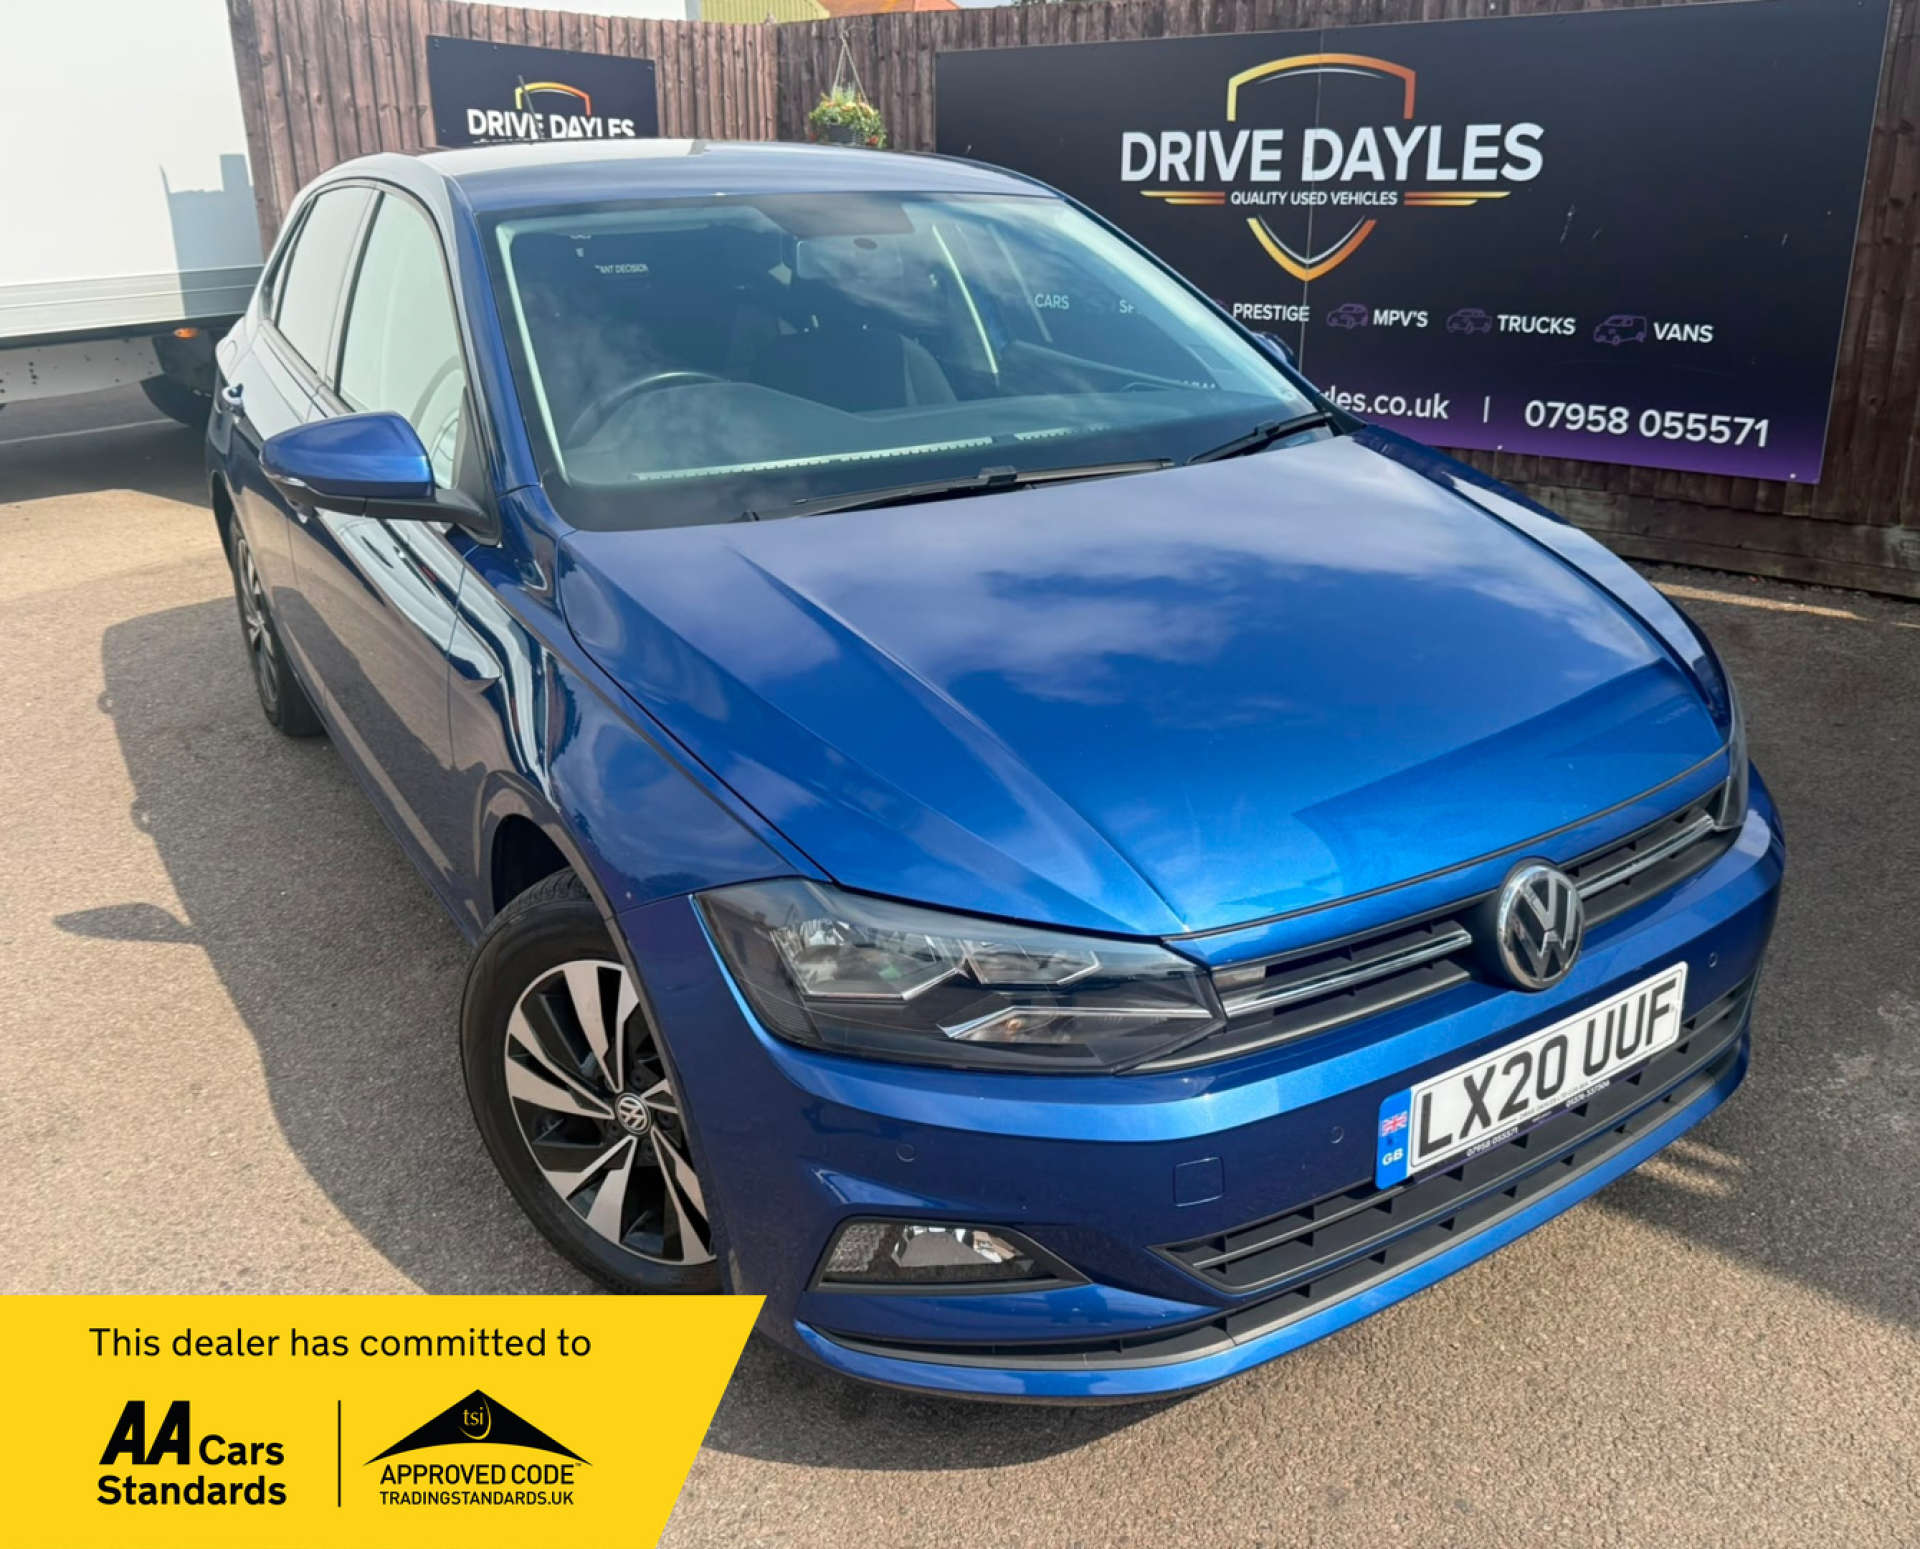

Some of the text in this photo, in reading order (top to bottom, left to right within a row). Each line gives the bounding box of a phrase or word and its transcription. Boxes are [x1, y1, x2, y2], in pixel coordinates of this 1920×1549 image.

[466, 108, 545, 140] DRIVE
[1120, 122, 1545, 182] DRIVE DAYLES
[1230, 191, 1398, 206] QUALITY USED VEHICLES
[1034, 293, 1070, 310] CARS
[1232, 303, 1310, 322] PRESTIGE
[1373, 309, 1429, 329] MPV'S
[1497, 314, 1577, 336] TRUCKS
[1653, 322, 1714, 344] VANS
[1524, 400, 1630, 434] 07958
[1638, 408, 1770, 448] 055571
[1417, 979, 1677, 1158] LX20 UUF
[1381, 1147, 1405, 1167] GB
